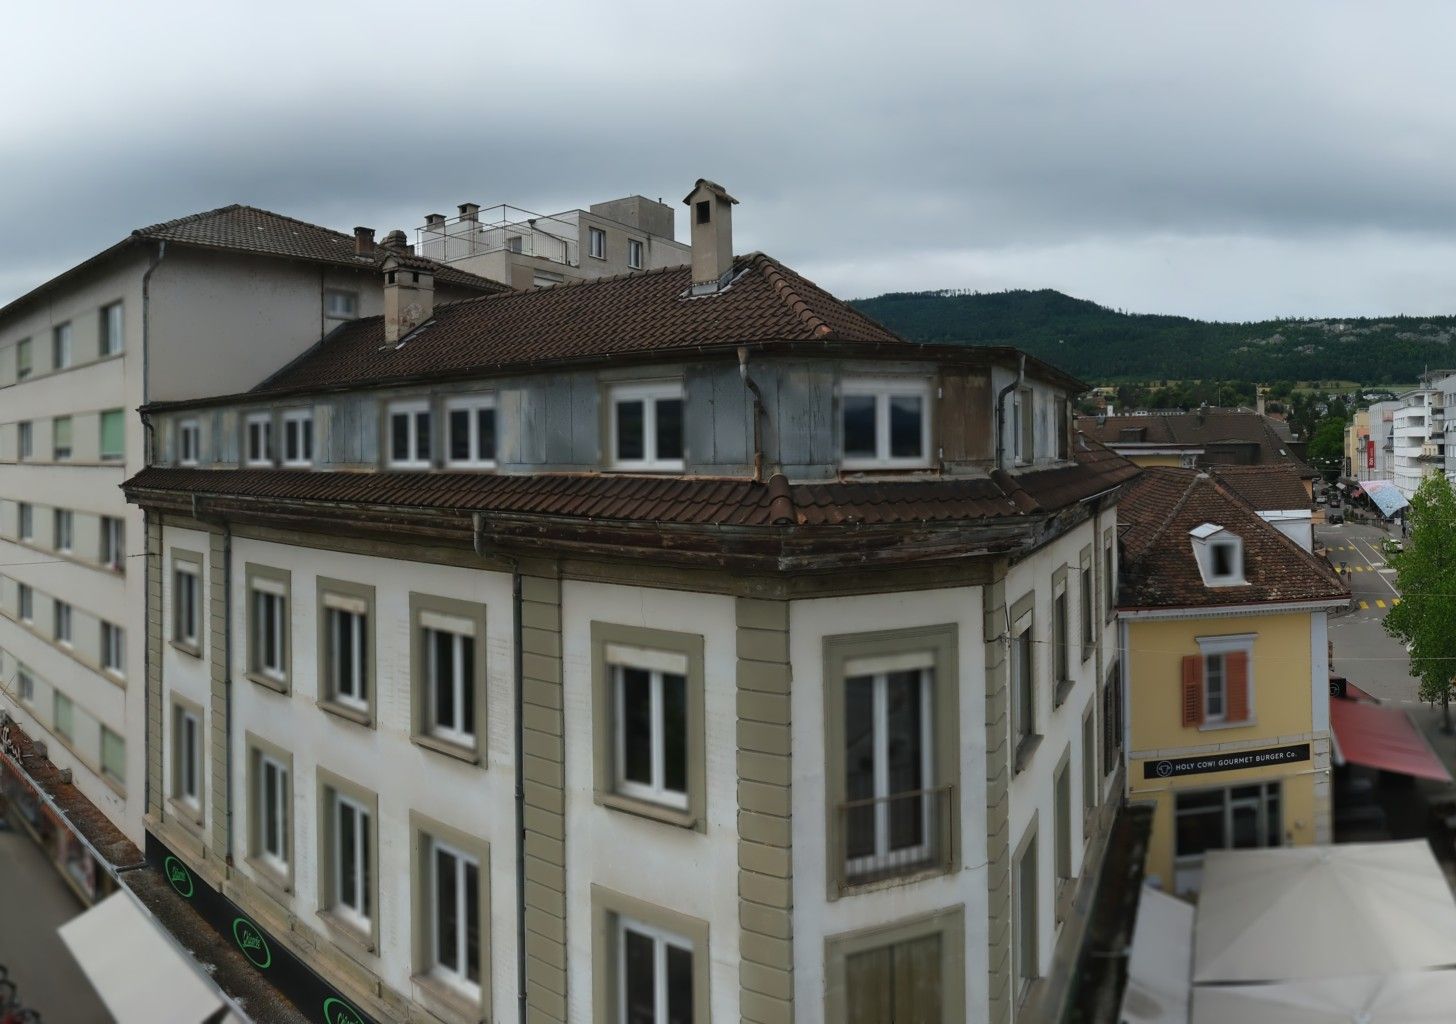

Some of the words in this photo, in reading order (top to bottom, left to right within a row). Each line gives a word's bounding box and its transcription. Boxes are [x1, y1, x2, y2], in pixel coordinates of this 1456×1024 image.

[1175, 763, 1195, 771] HOLY
[1197, 761, 1216, 769] COW!
[1218, 756, 1253, 766] GOURMET
[1255, 753, 1284, 762] BURGER
